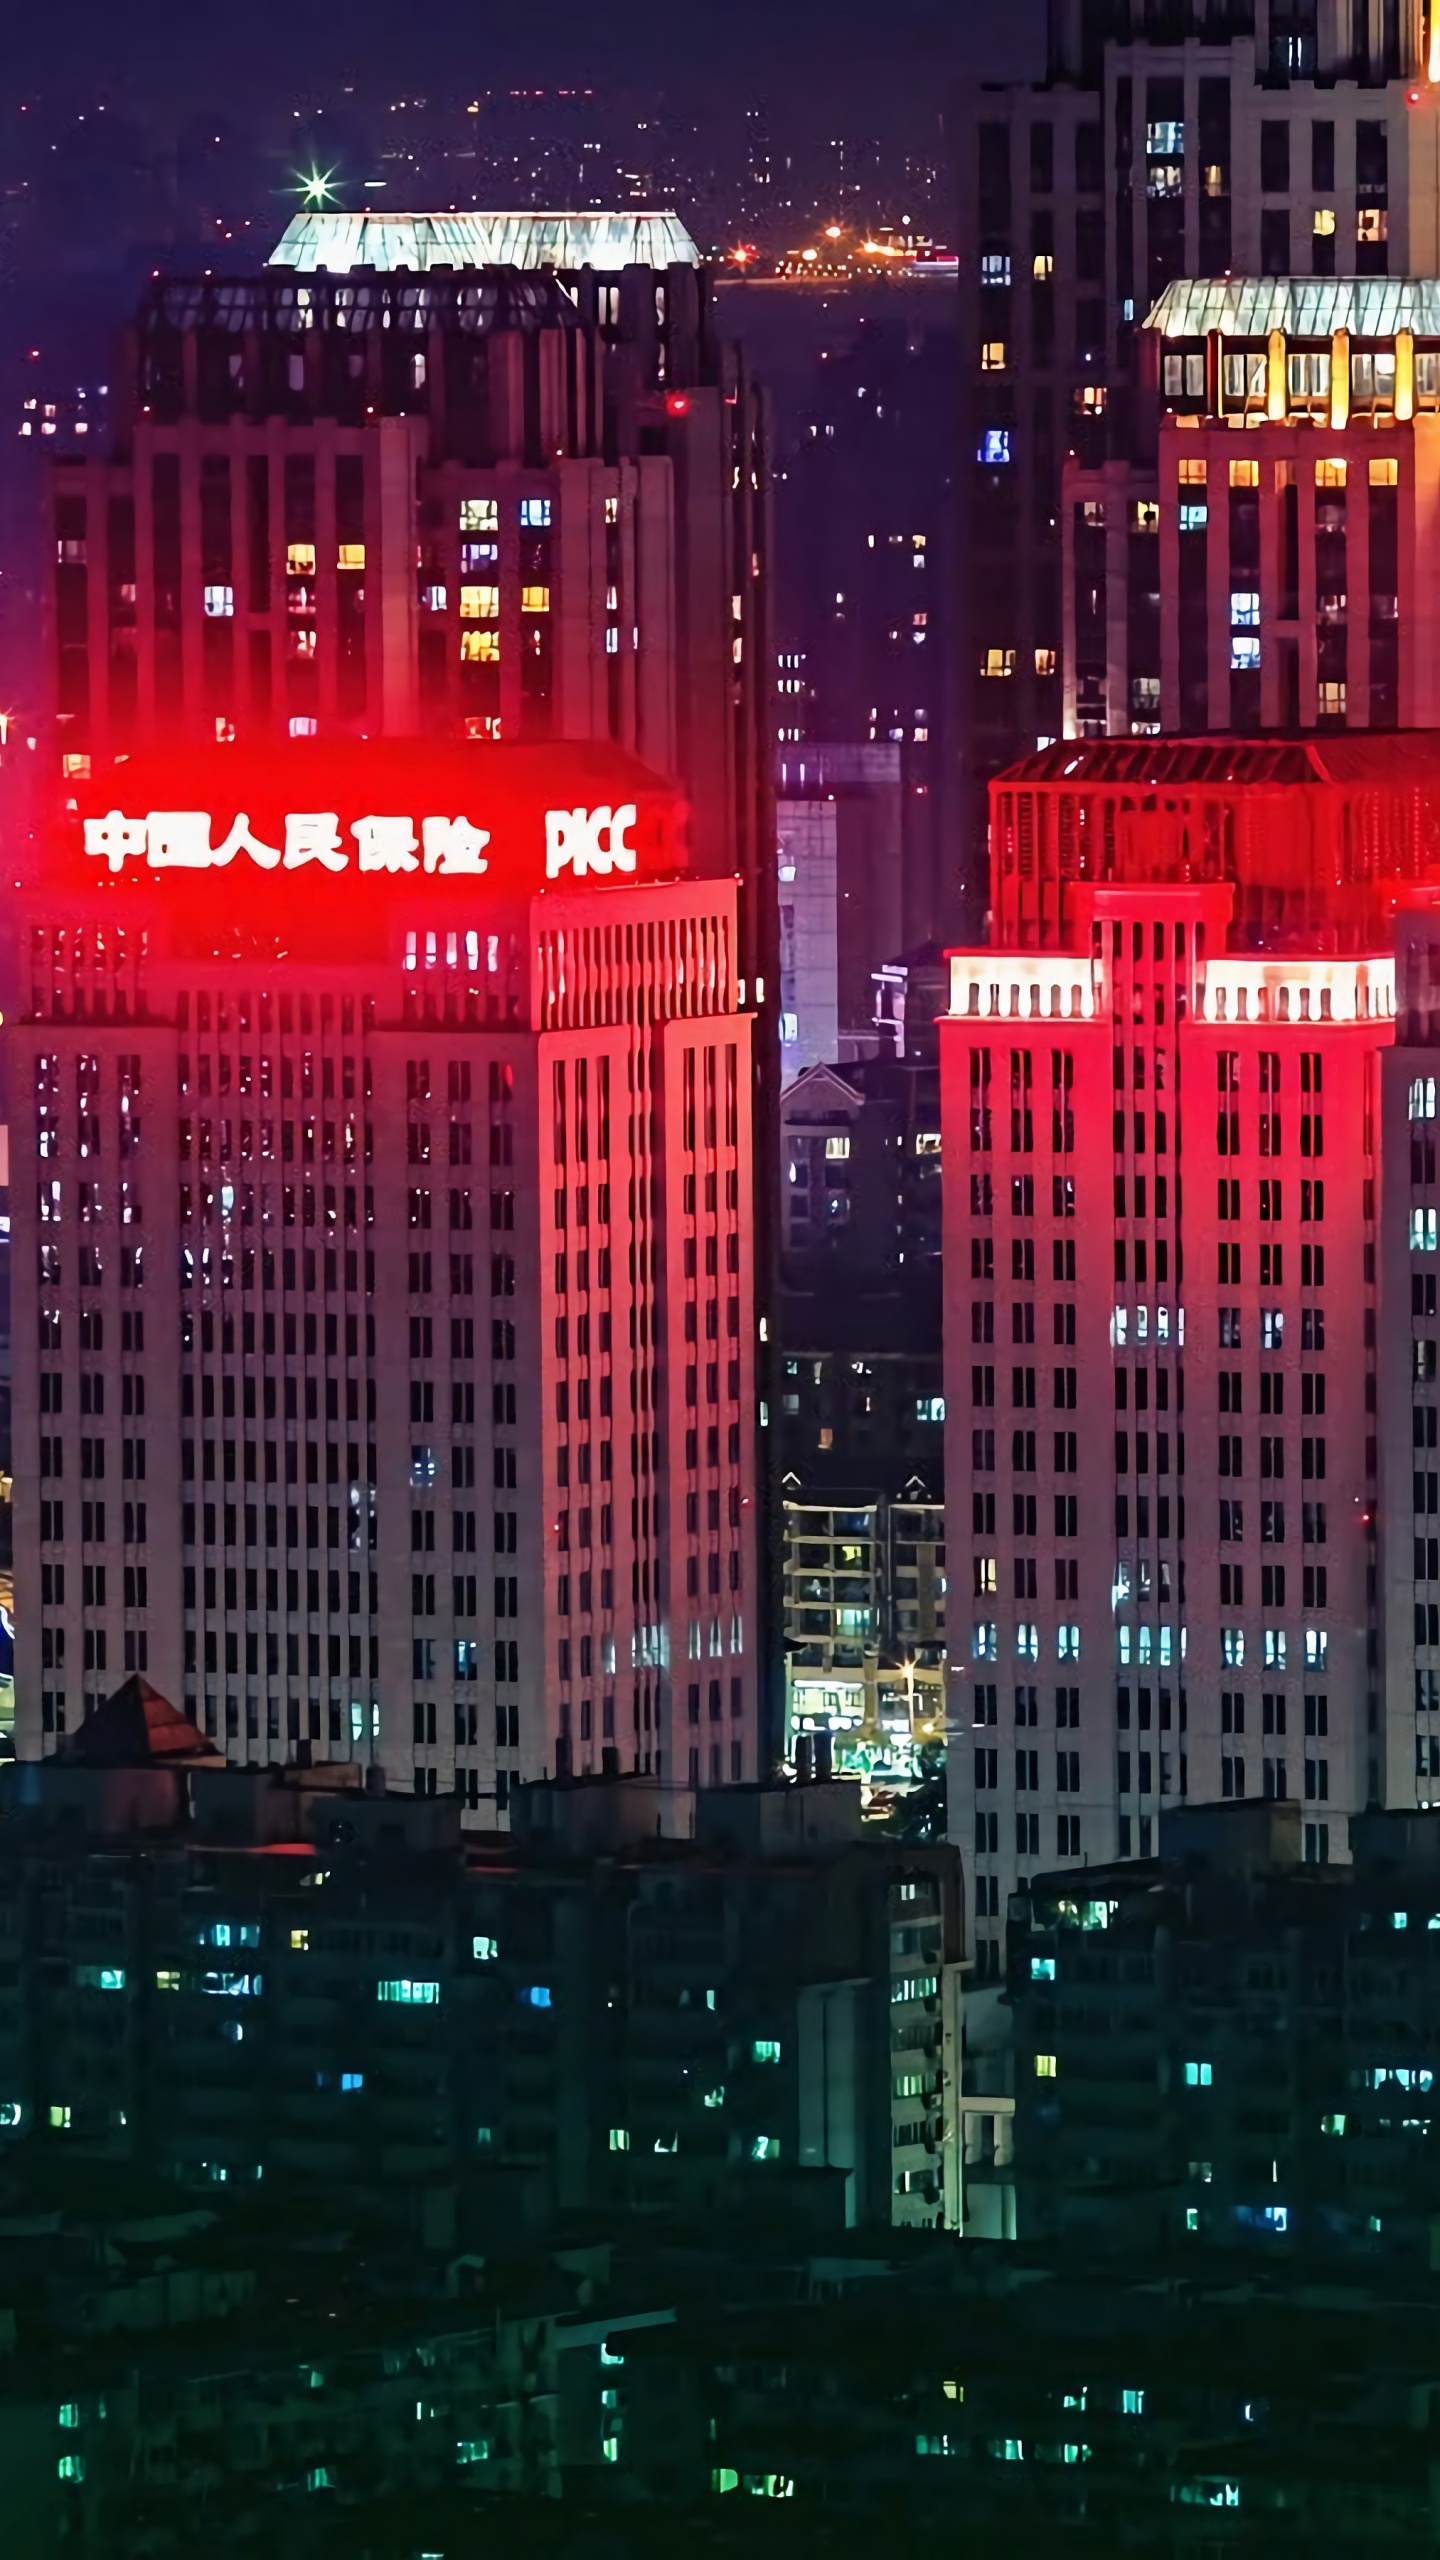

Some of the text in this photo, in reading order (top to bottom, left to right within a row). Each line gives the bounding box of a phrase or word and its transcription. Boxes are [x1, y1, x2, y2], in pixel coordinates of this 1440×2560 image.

[84, 804, 637, 878] 中国人民保险 PICC
